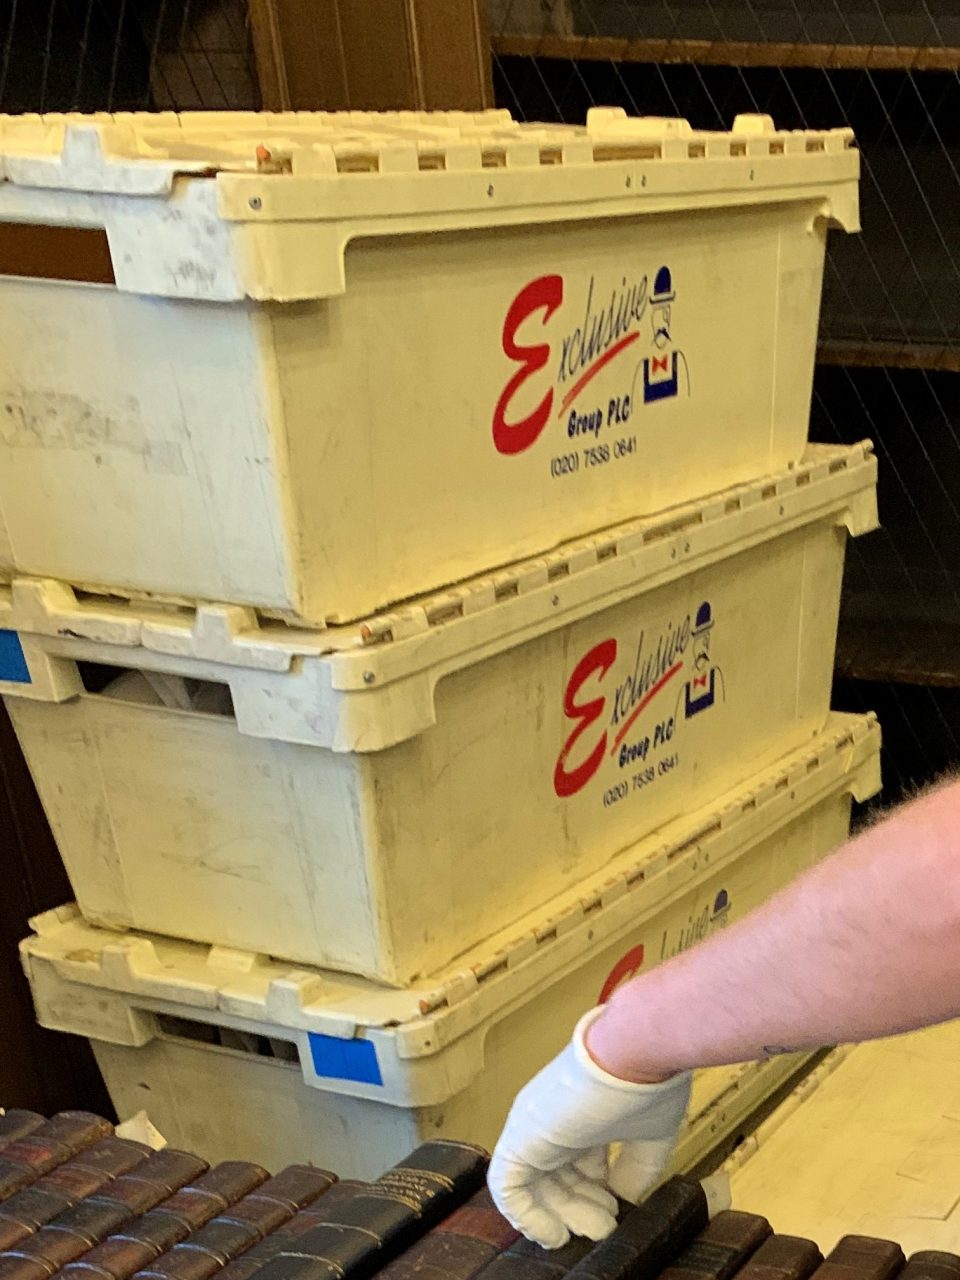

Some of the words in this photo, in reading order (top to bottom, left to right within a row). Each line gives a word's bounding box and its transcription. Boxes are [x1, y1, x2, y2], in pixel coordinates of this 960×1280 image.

[492, 273, 649, 456] Exclusive
[567, 407, 603, 439] Group
[606, 394, 631, 429] PLC
[550, 451, 580, 478] (020)
[553, 614, 692, 798] Exclusive
[618, 735, 650, 769] Group
[653, 716, 674, 749] PLC
